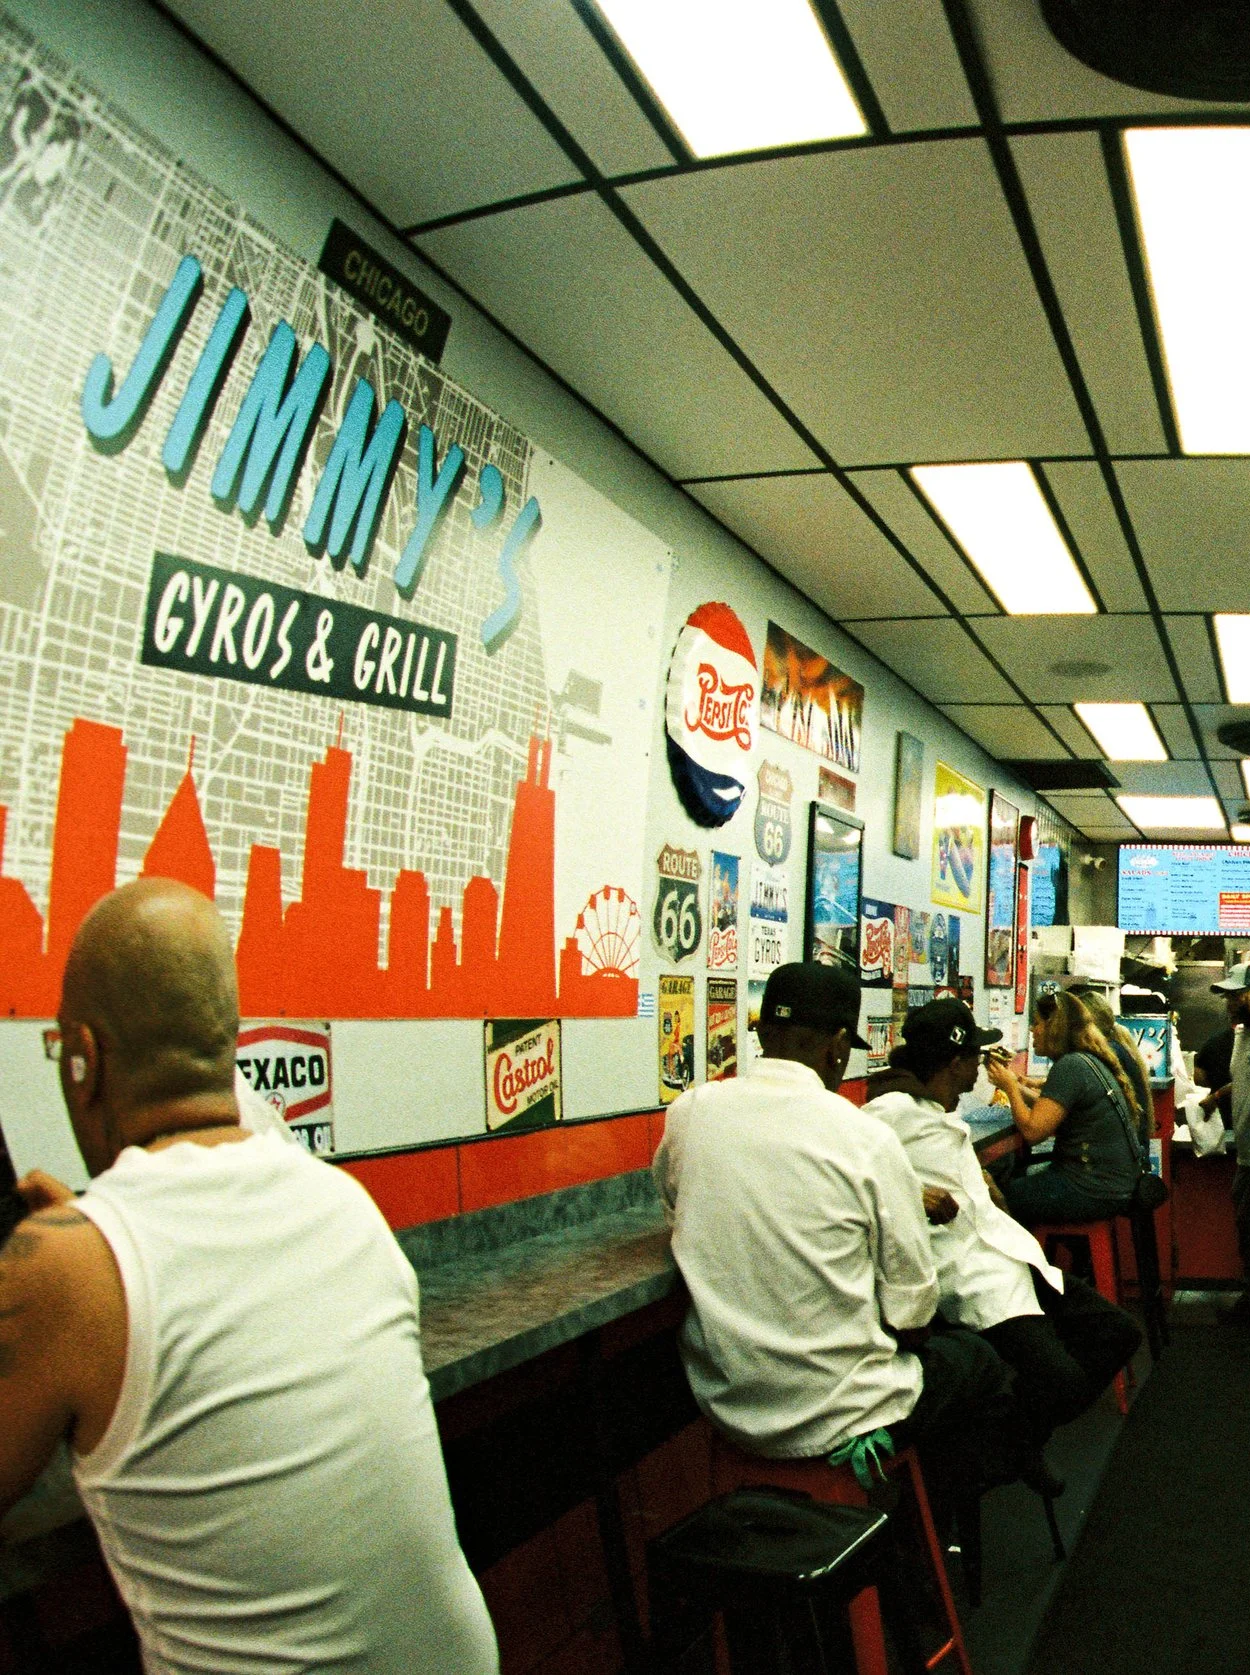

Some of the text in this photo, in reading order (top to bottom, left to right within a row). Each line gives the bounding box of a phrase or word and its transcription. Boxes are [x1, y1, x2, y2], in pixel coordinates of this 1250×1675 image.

[344, 250, 429, 337] CHICAGO
[81, 255, 541, 648] JIMMY'S
[153, 570, 447, 705] GYROS & GRILL
[760, 801, 790, 824] ROUTE
[763, 821, 784, 857] 66
[662, 851, 698, 880] ROUTE
[660, 888, 696, 950] 66
[754, 936, 782, 965] GYROS
[661, 980, 692, 995] GARAGE
[709, 986, 737, 1000] GARAGE
[515, 1033, 542, 1055] PATENT
[236, 1055, 325, 1091] EXACO
[493, 1037, 555, 1115] Castrol
[526, 1080, 559, 1105] MOTOR OIL
